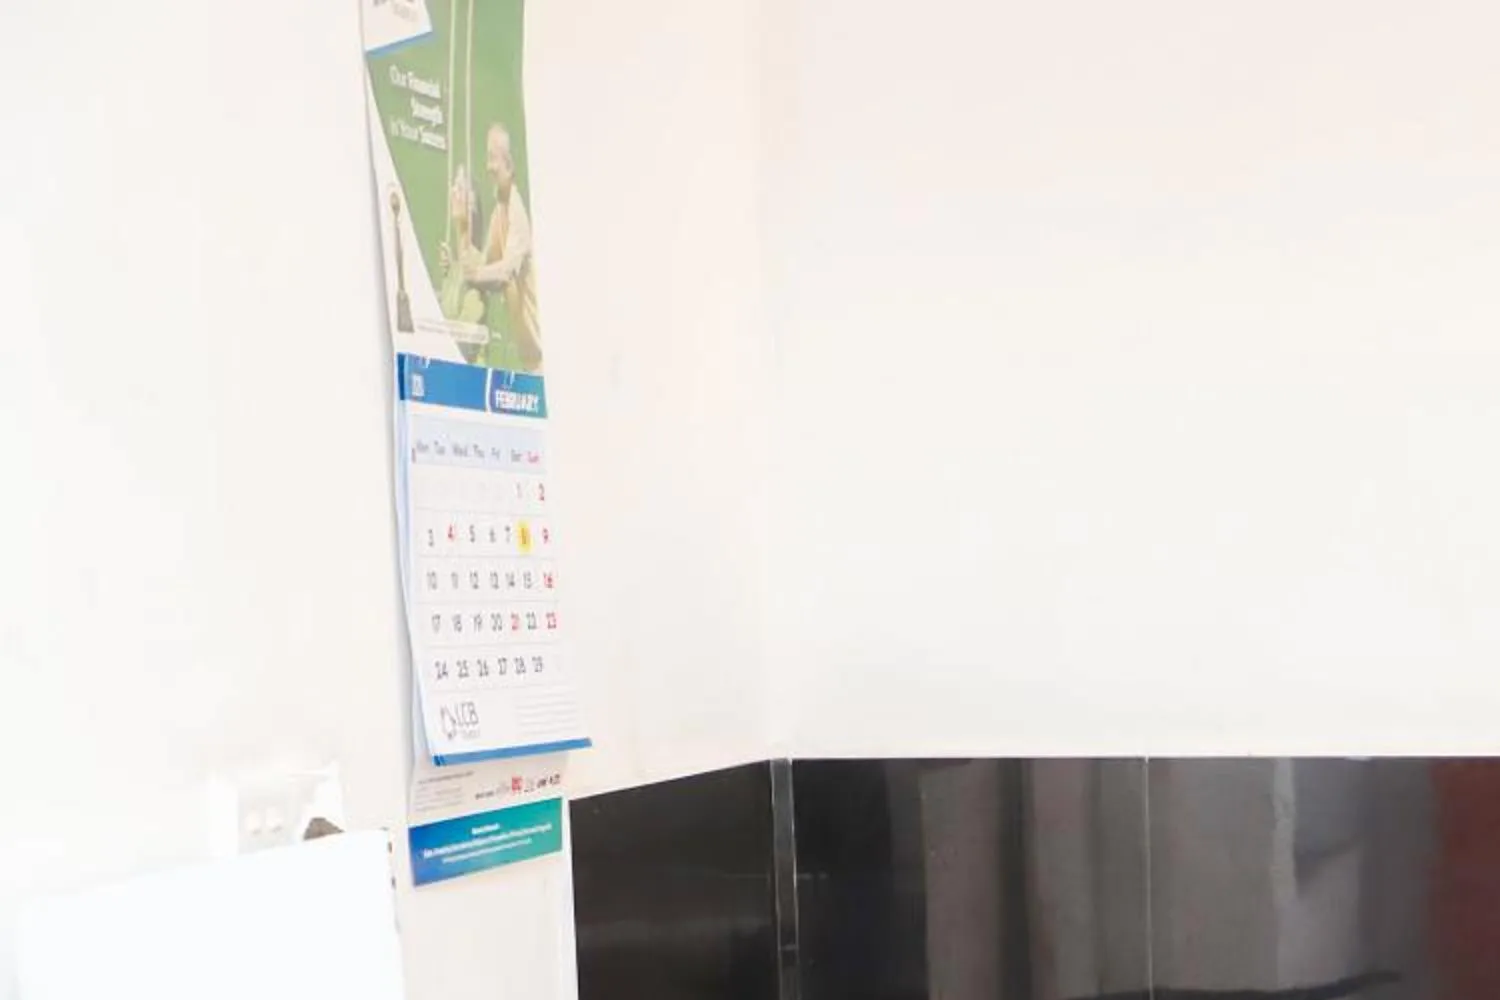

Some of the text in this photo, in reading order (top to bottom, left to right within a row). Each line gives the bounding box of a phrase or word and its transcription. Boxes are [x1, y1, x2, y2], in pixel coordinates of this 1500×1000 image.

[496, 389, 539, 414] FEBRUARY
[427, 571, 438, 590] 10
[470, 571, 480, 589] 12
[489, 571, 500, 589] 13
[505, 571, 516, 588] 14
[523, 571, 532, 588] 15
[543, 572, 554, 588] 16
[432, 613, 442, 632] 17
[452, 614, 463, 632] 18
[473, 613, 483, 631] 19
[490, 612, 503, 631] 20
[526, 611, 537, 630] 22
[545, 611, 557, 629] 23
[434, 655, 543, 679] 24 25 26 27 28 29
[454, 701, 479, 726] LCB
